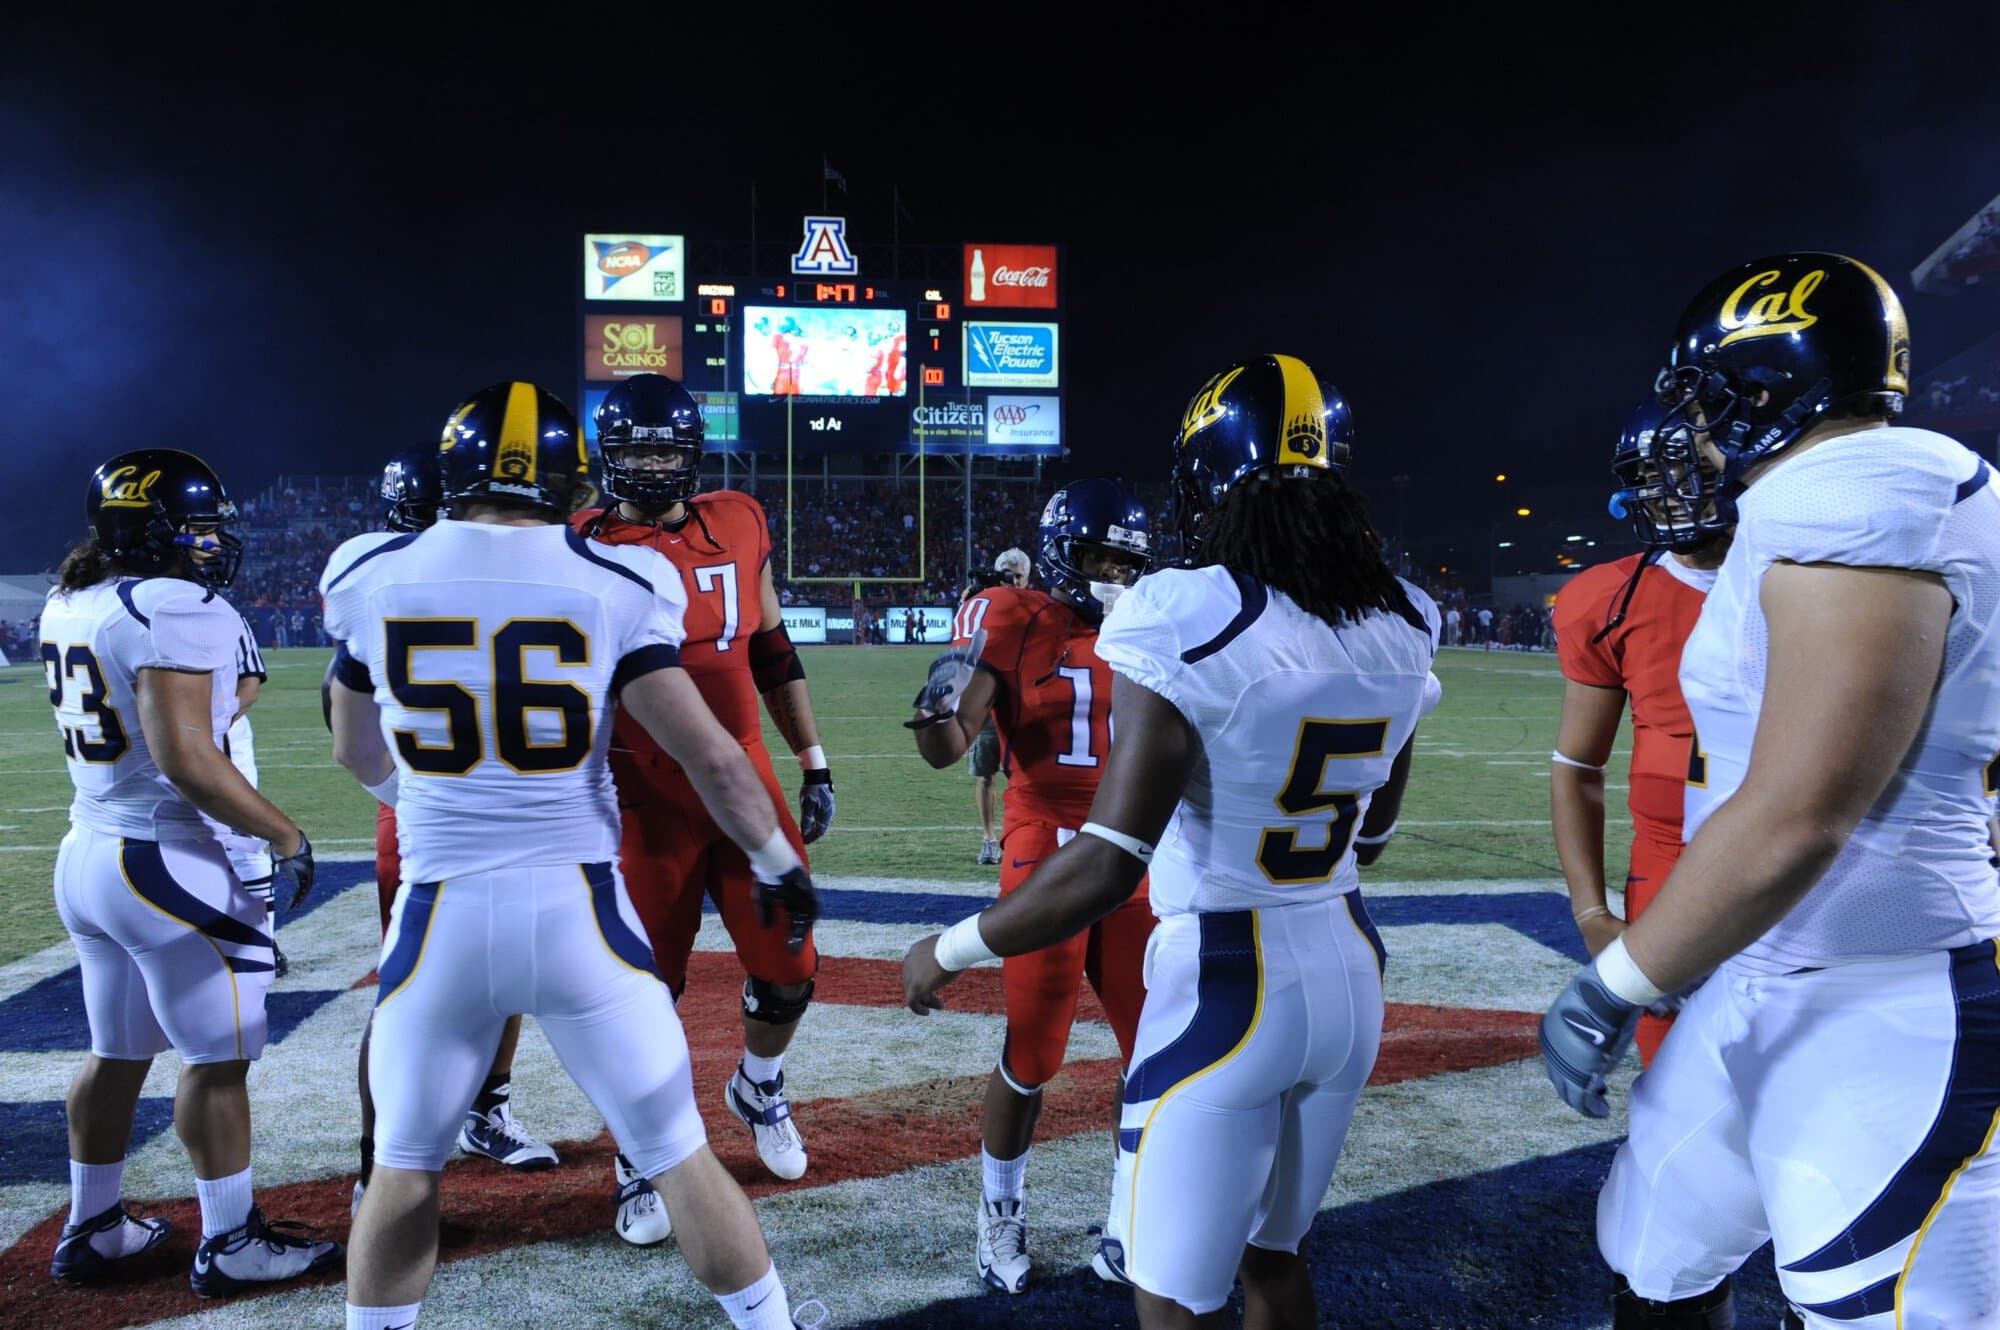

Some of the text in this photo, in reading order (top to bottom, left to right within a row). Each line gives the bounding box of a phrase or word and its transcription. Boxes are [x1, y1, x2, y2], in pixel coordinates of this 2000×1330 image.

[606, 256, 641, 269] NCAA
[992, 266, 1052, 287] Coca-Cola
[776, 285, 785, 298] 3
[865, 287, 874, 300] 3
[711, 299, 725, 314] 0
[936, 304, 949, 319] 0
[1718, 269, 1826, 348] Cal
[603, 323, 666, 353] SOL
[989, 331, 1033, 345] Tucson
[993, 343, 1045, 357] Electric
[603, 353, 667, 368] CASINOS
[999, 355, 1045, 369] Power
[912, 406, 984, 425] Citizen
[1010, 428, 1054, 438] Insurance
[1302, 439, 1311, 452] 5
[101, 465, 162, 508] Cal
[680, 560, 740, 652] 7
[800, 619, 821, 628] MILK
[926, 619, 947, 628] MILK
[382, 617, 593, 777] 56
[1254, 717, 1391, 885] 5
